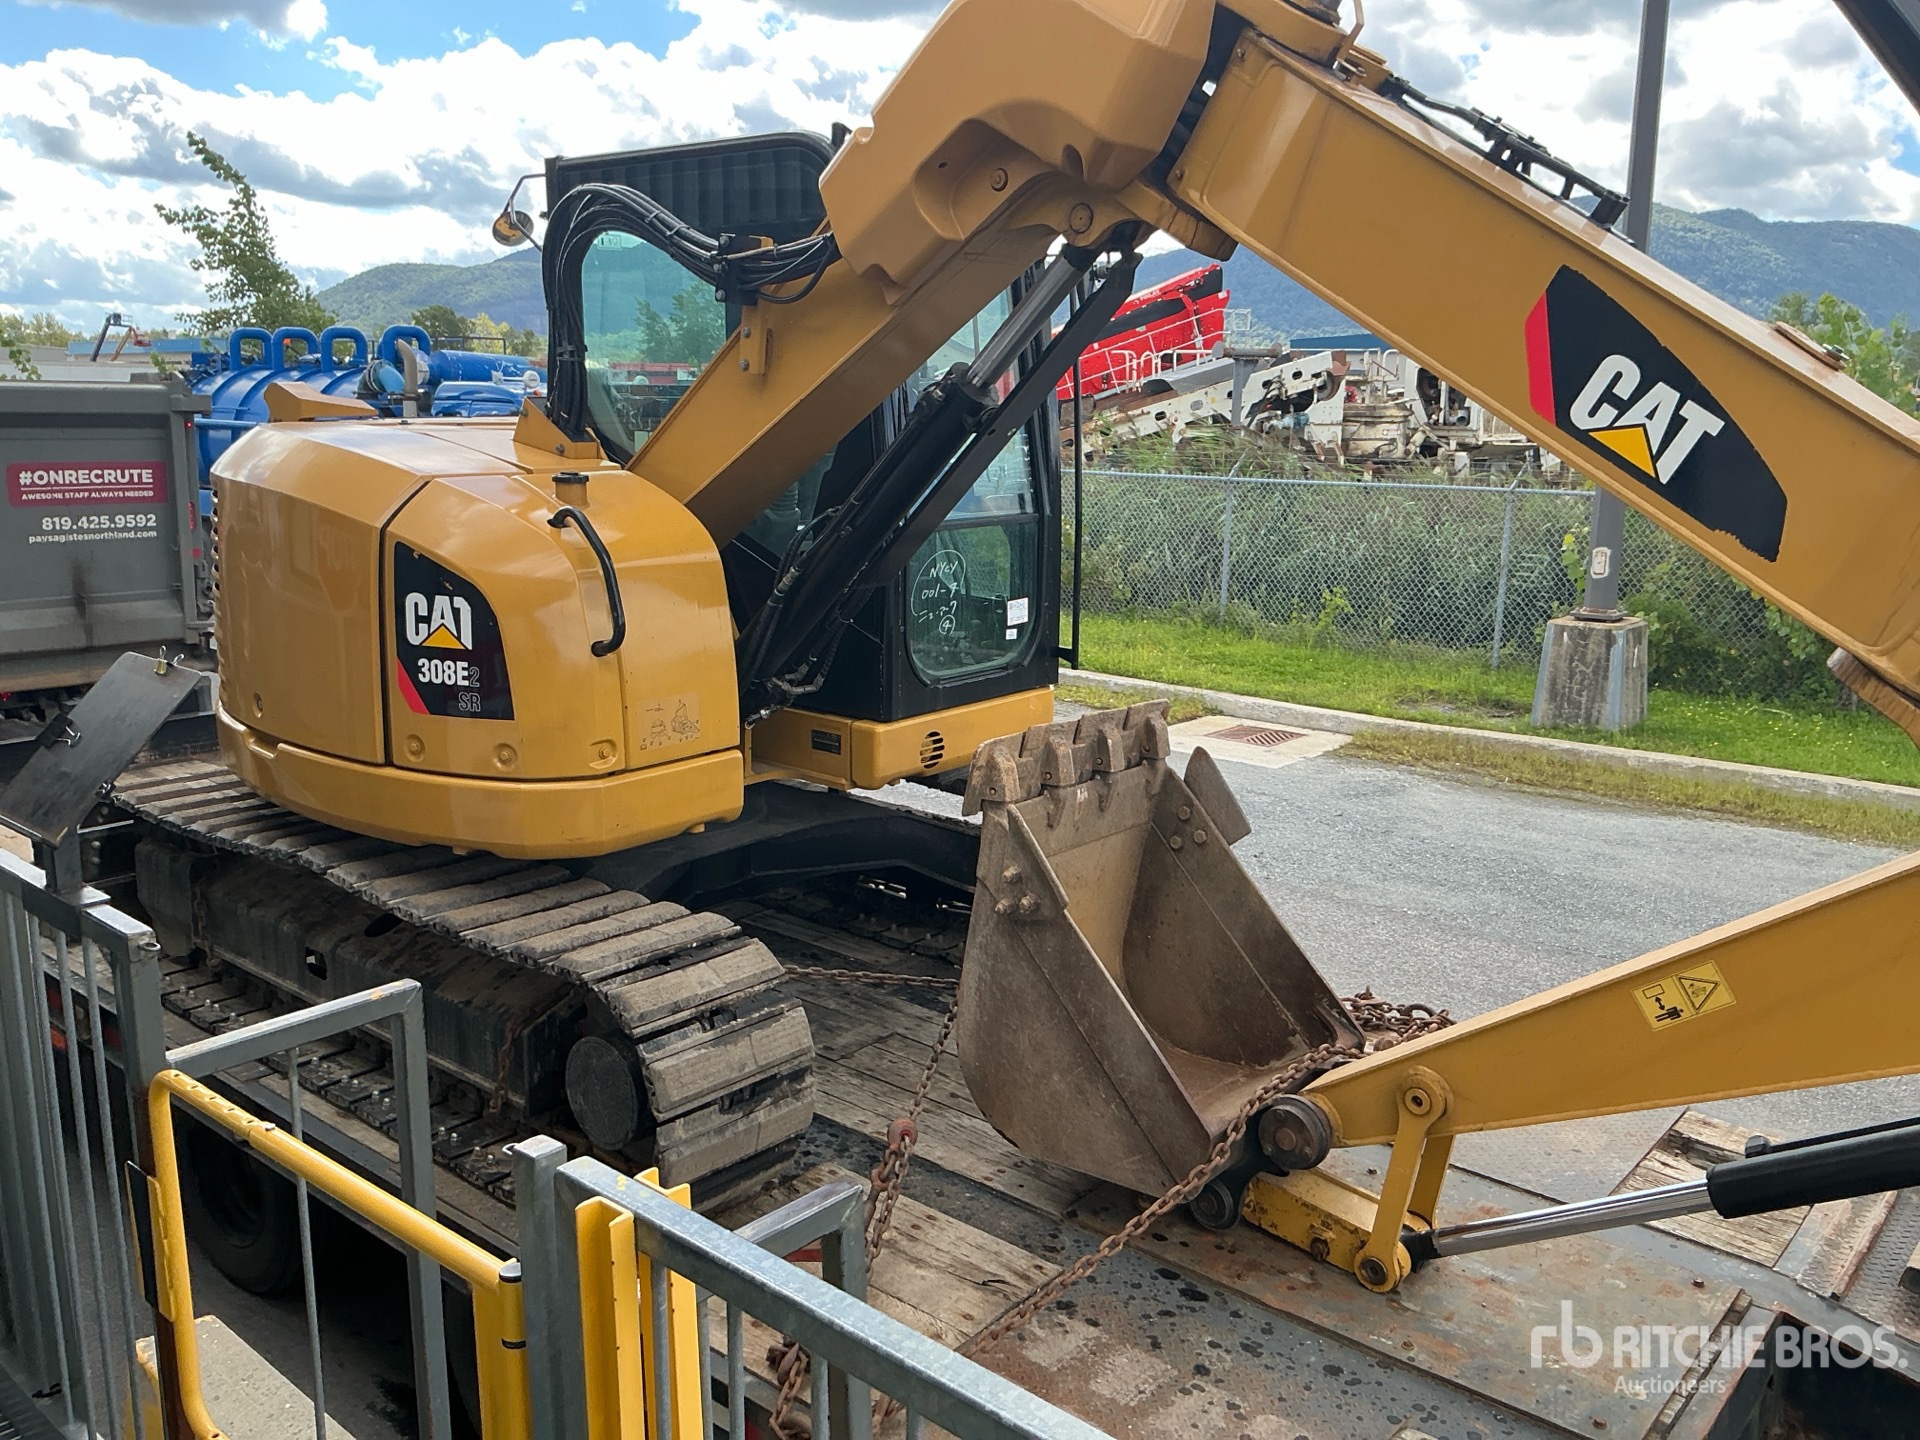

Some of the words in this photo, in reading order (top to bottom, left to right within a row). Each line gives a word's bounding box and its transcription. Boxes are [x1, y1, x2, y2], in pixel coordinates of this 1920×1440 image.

[1569, 353, 1726, 485] CAT
[19, 469, 153, 485] #ONRECRUTE
[21, 492, 63, 501] AWESOME
[64, 491, 90, 499] STAFF
[90, 490, 123, 498] ALWAYS
[124, 490, 154, 498] NEEDED
[42, 514, 157, 530] 819.425.9592
[29, 531, 157, 544] paysagistesnorthland.com
[405, 591, 473, 650] CAT
[458, 691, 481, 712] SR
